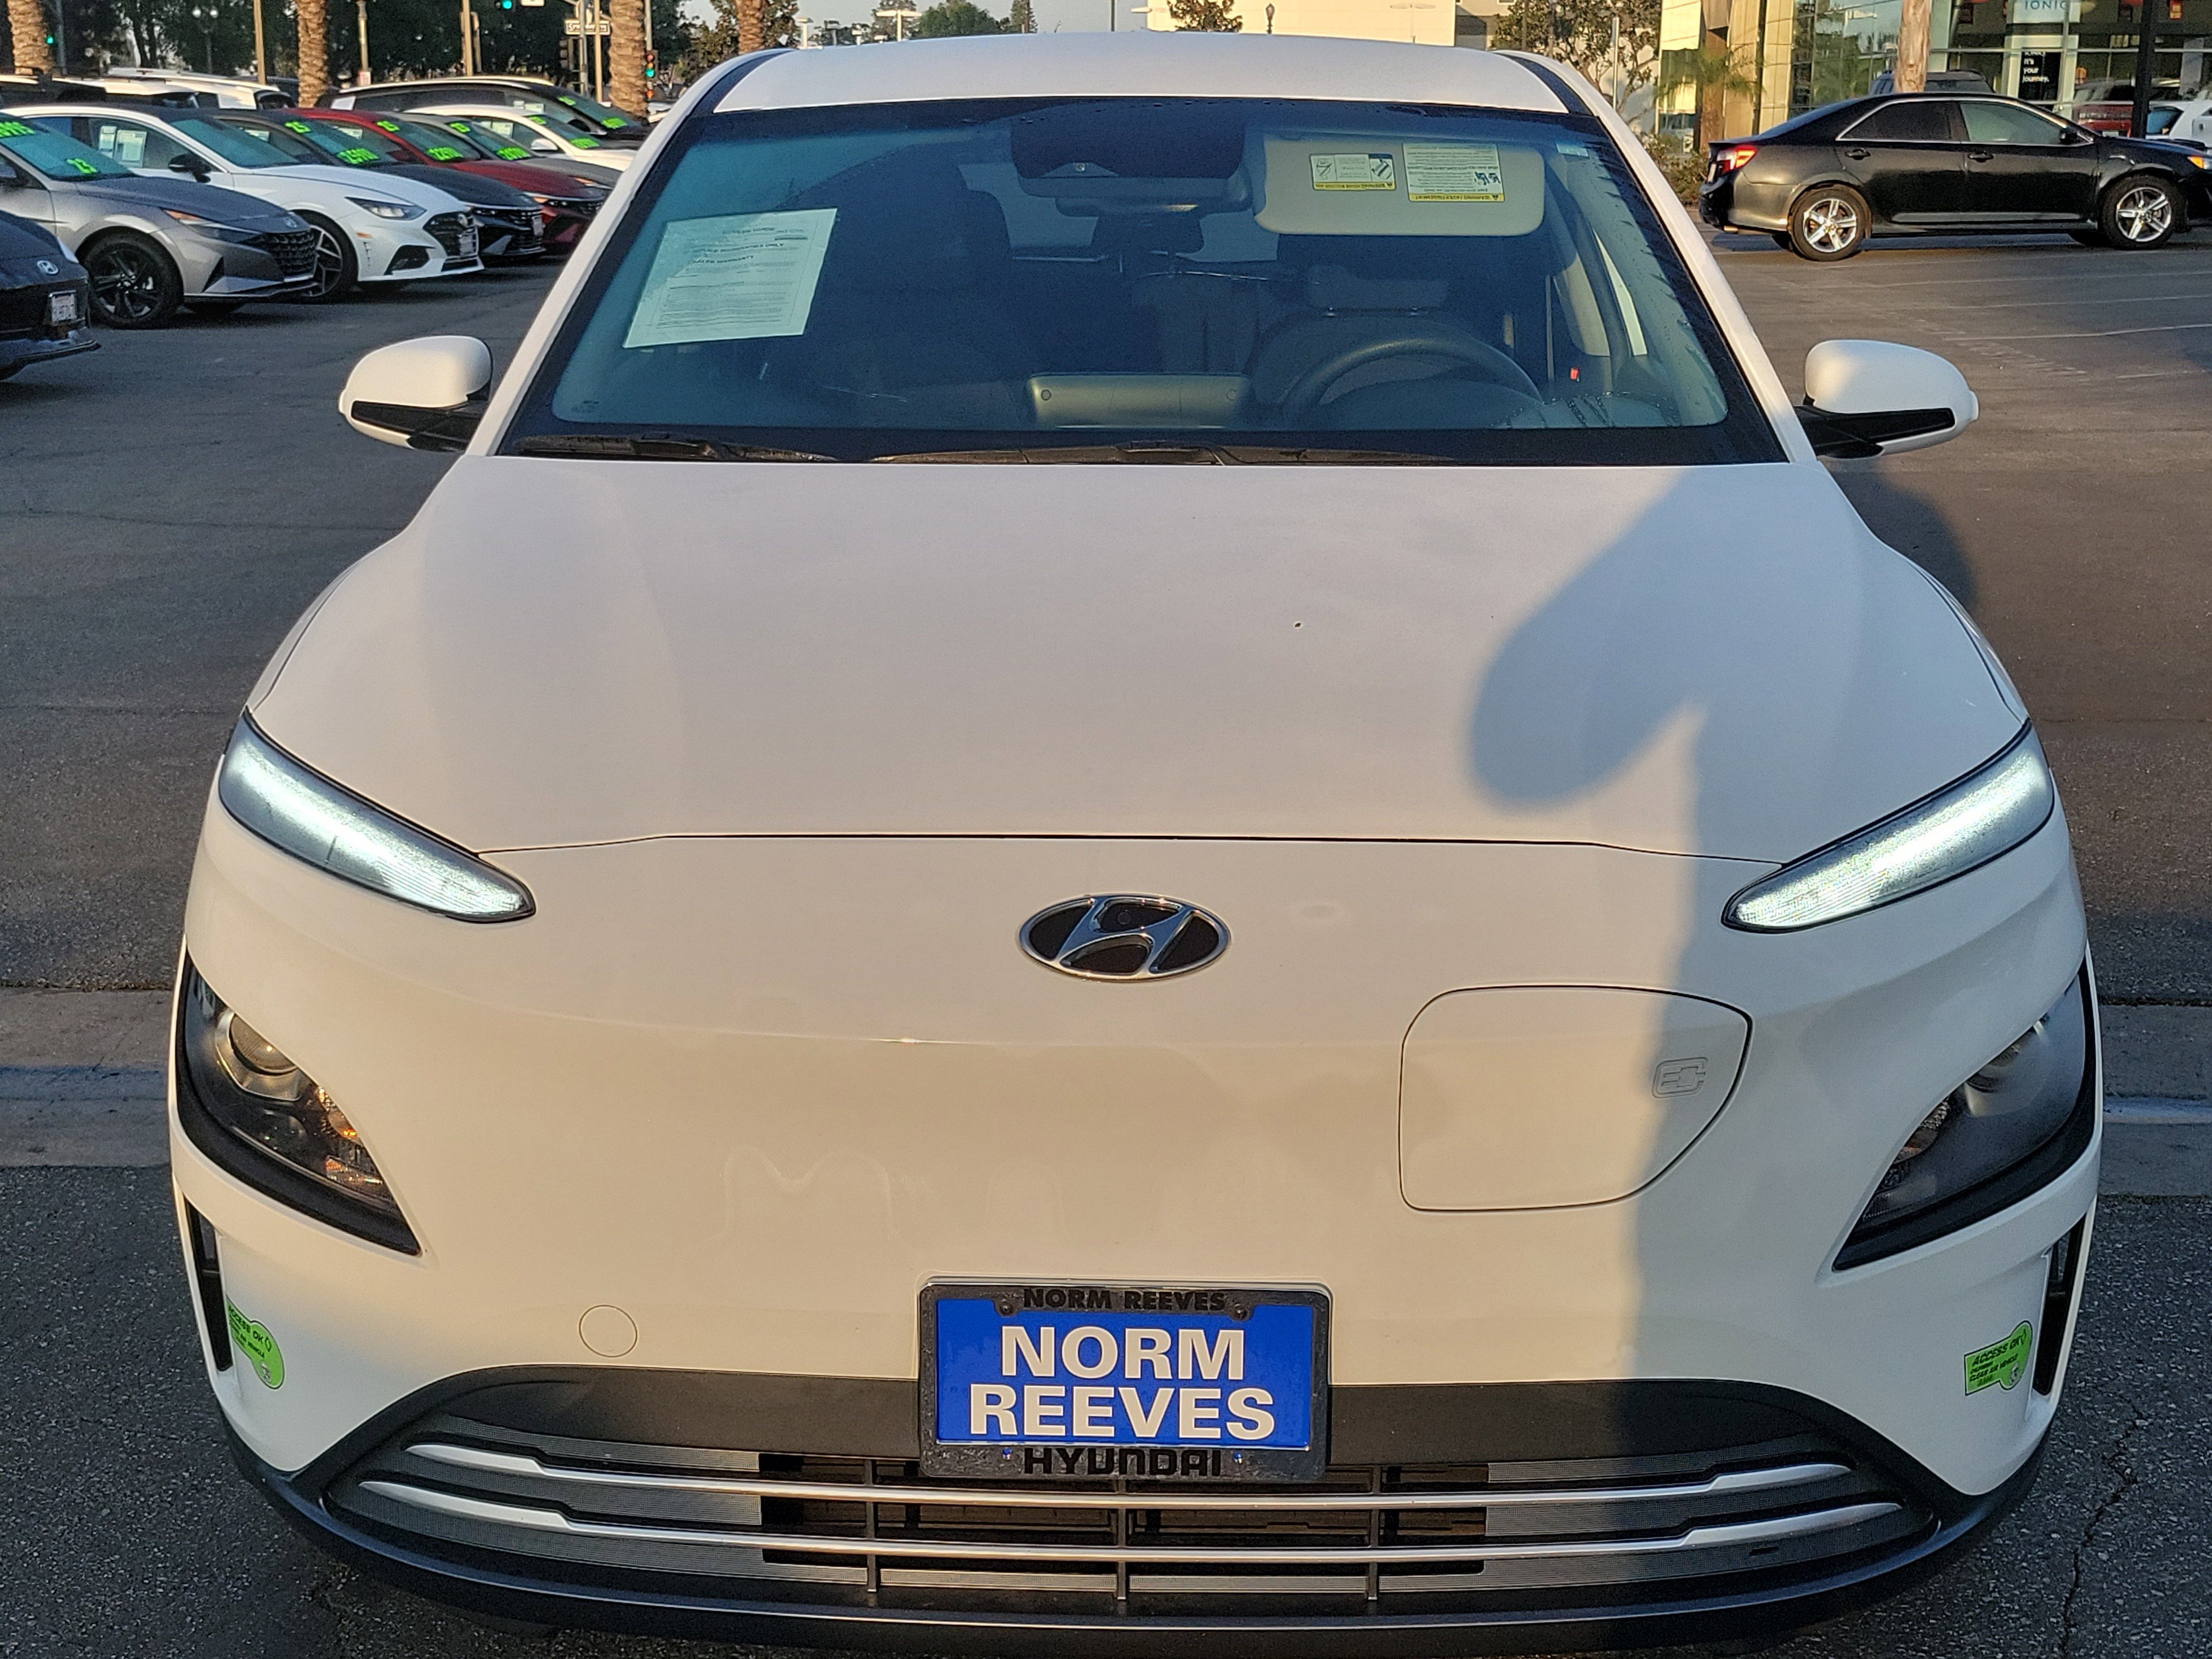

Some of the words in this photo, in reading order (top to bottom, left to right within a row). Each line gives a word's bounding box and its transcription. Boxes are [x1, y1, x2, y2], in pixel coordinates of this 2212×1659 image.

[1023, 1288, 1111, 1310] NORM
[1124, 1291, 1227, 1312] REEVES
[1001, 1325, 1245, 1380] NORM
[969, 1384, 1276, 1440] REEVES
[1024, 1448, 1221, 1477] HYUNDAI
